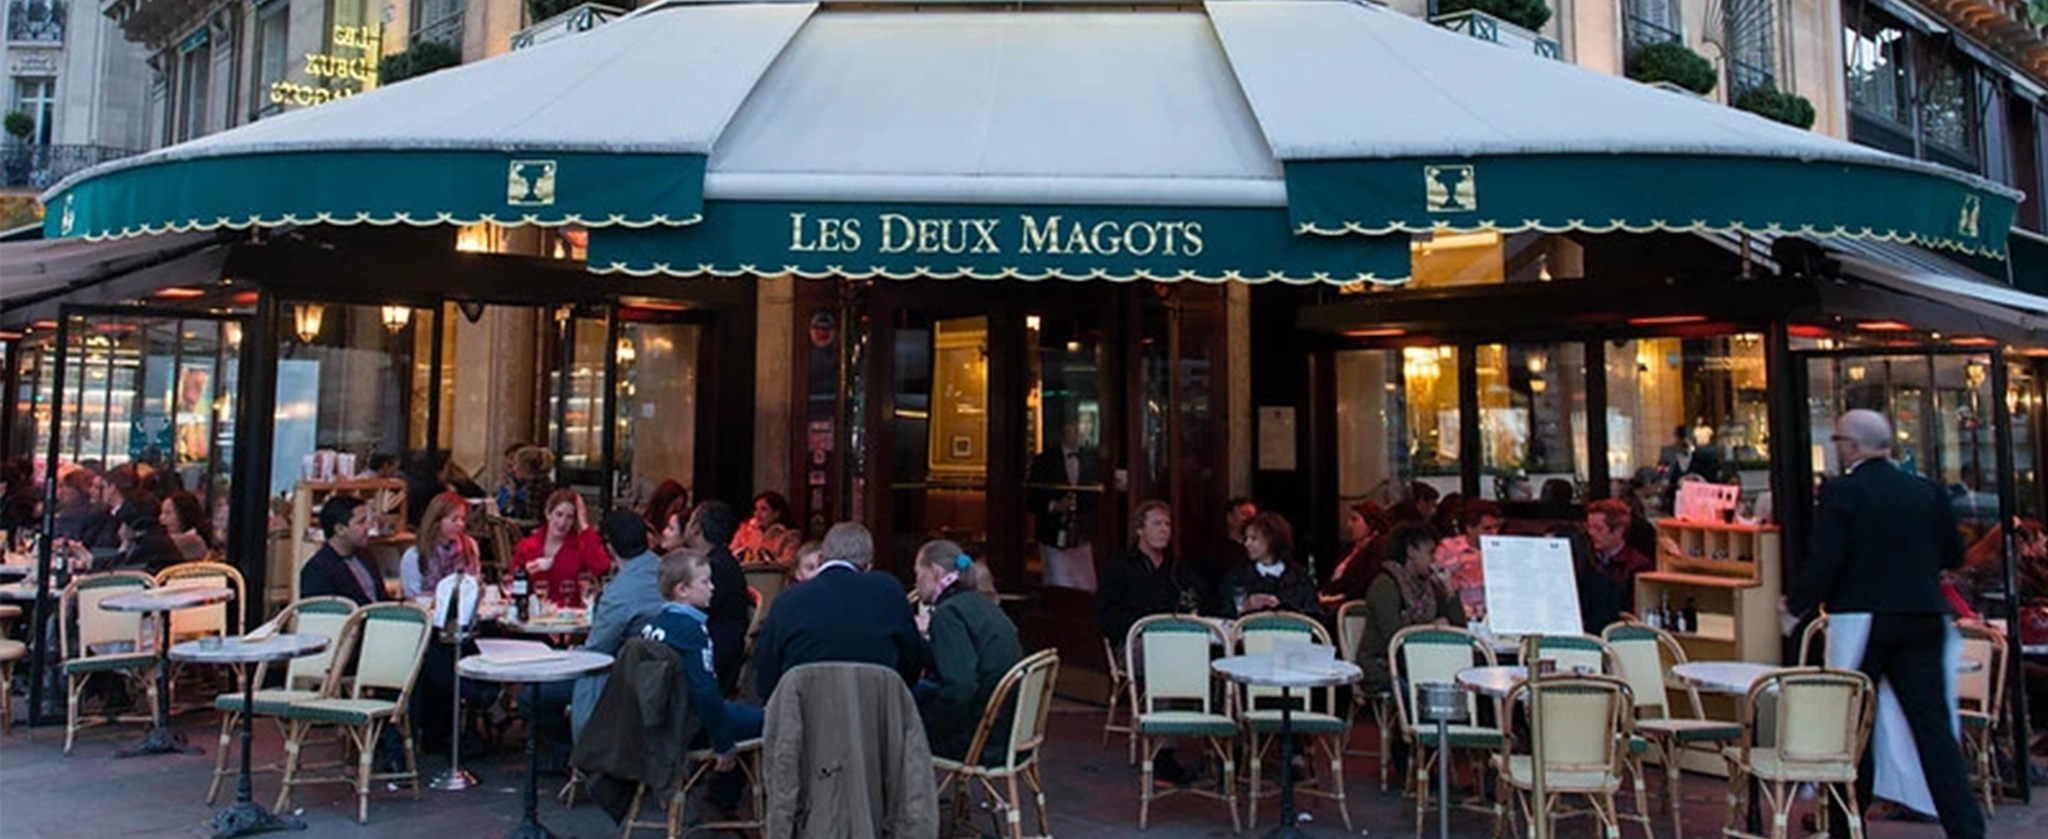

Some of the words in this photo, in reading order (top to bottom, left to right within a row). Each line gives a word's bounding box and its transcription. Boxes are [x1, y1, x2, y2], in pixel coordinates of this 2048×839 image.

[788, 212, 862, 253] LES
[878, 213, 1001, 254] DEUX
[1018, 214, 1204, 257] MAGOTS
